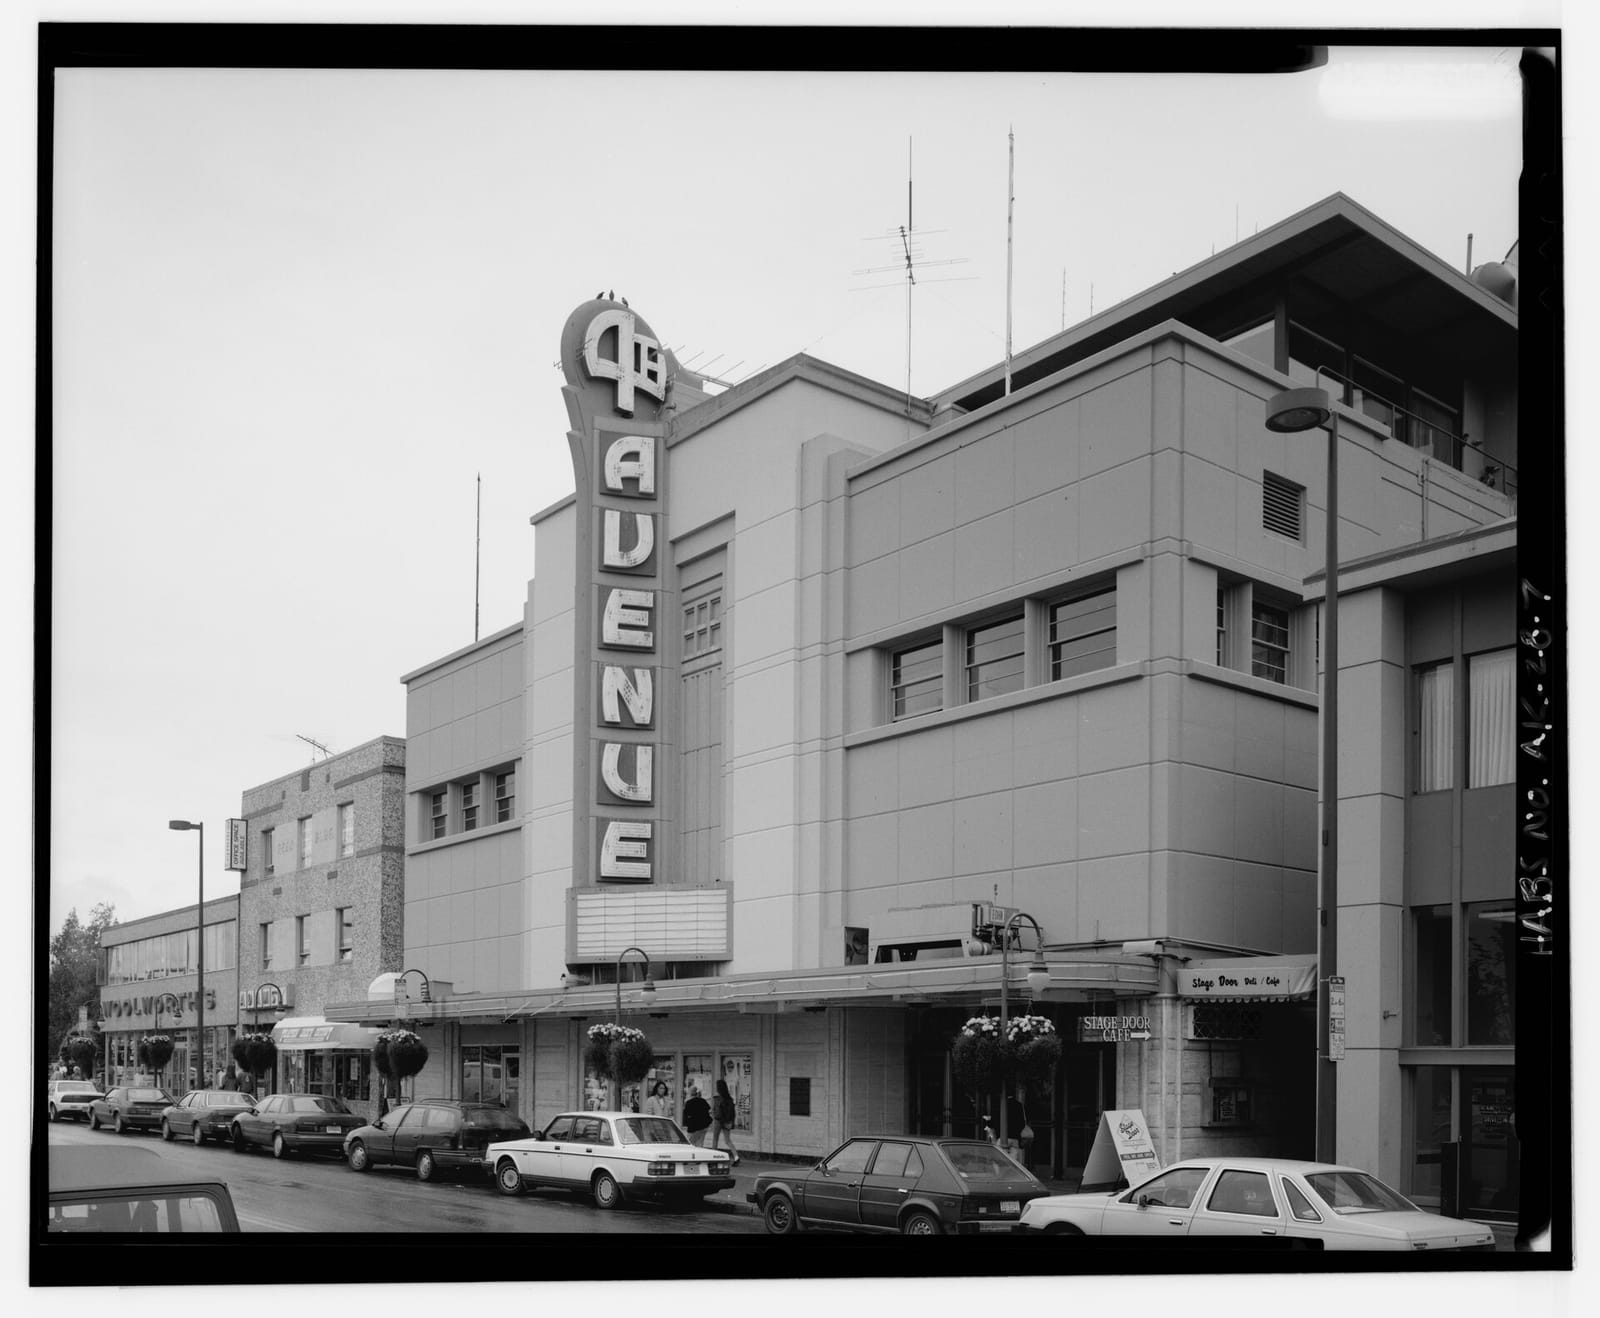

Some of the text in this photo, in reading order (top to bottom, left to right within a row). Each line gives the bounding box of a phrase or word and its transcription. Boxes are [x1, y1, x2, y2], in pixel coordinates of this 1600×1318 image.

[1192, 977, 1215, 991] Stage
[1218, 975, 1239, 987] Door
[1084, 1016, 1151, 1030] STAGE DOOR
[1103, 1029, 1131, 1042] CAFE
